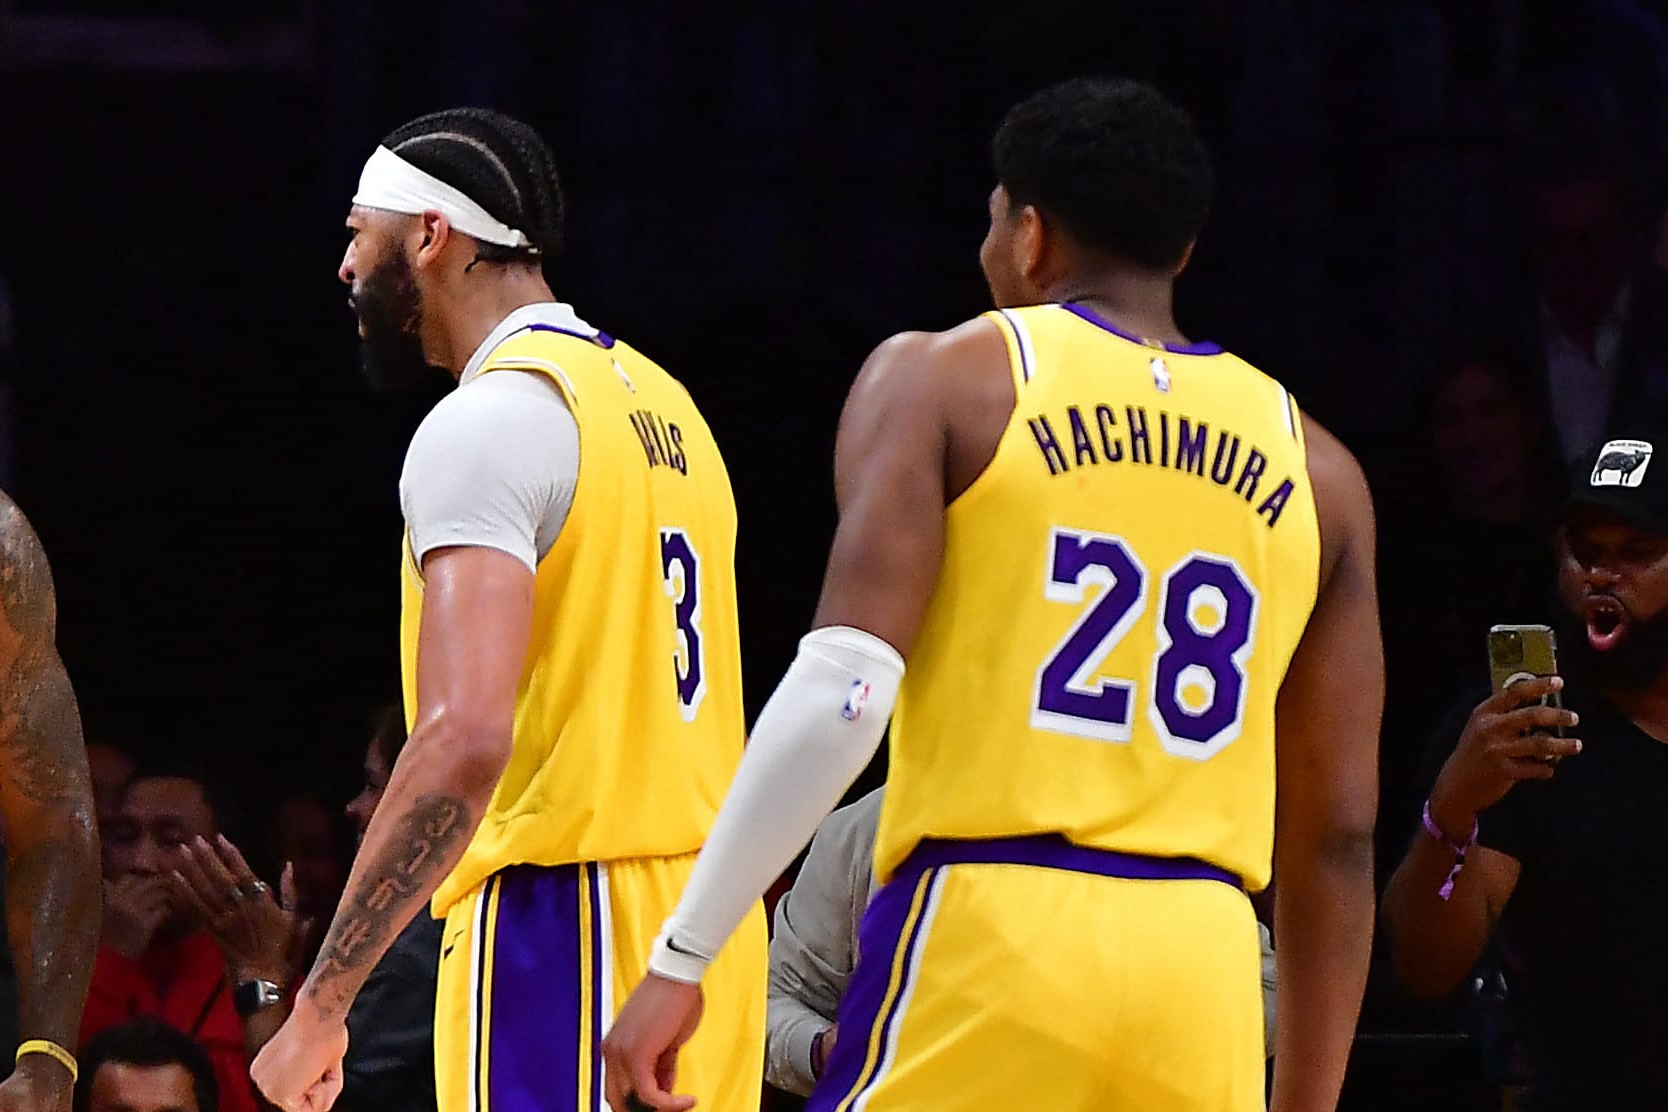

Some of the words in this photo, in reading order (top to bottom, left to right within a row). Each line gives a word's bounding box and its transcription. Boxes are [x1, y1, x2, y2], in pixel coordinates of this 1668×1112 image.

[1027, 404, 1295, 528] HACHIMURA
[659, 526, 707, 723] 3
[1029, 527, 1261, 761] 28
